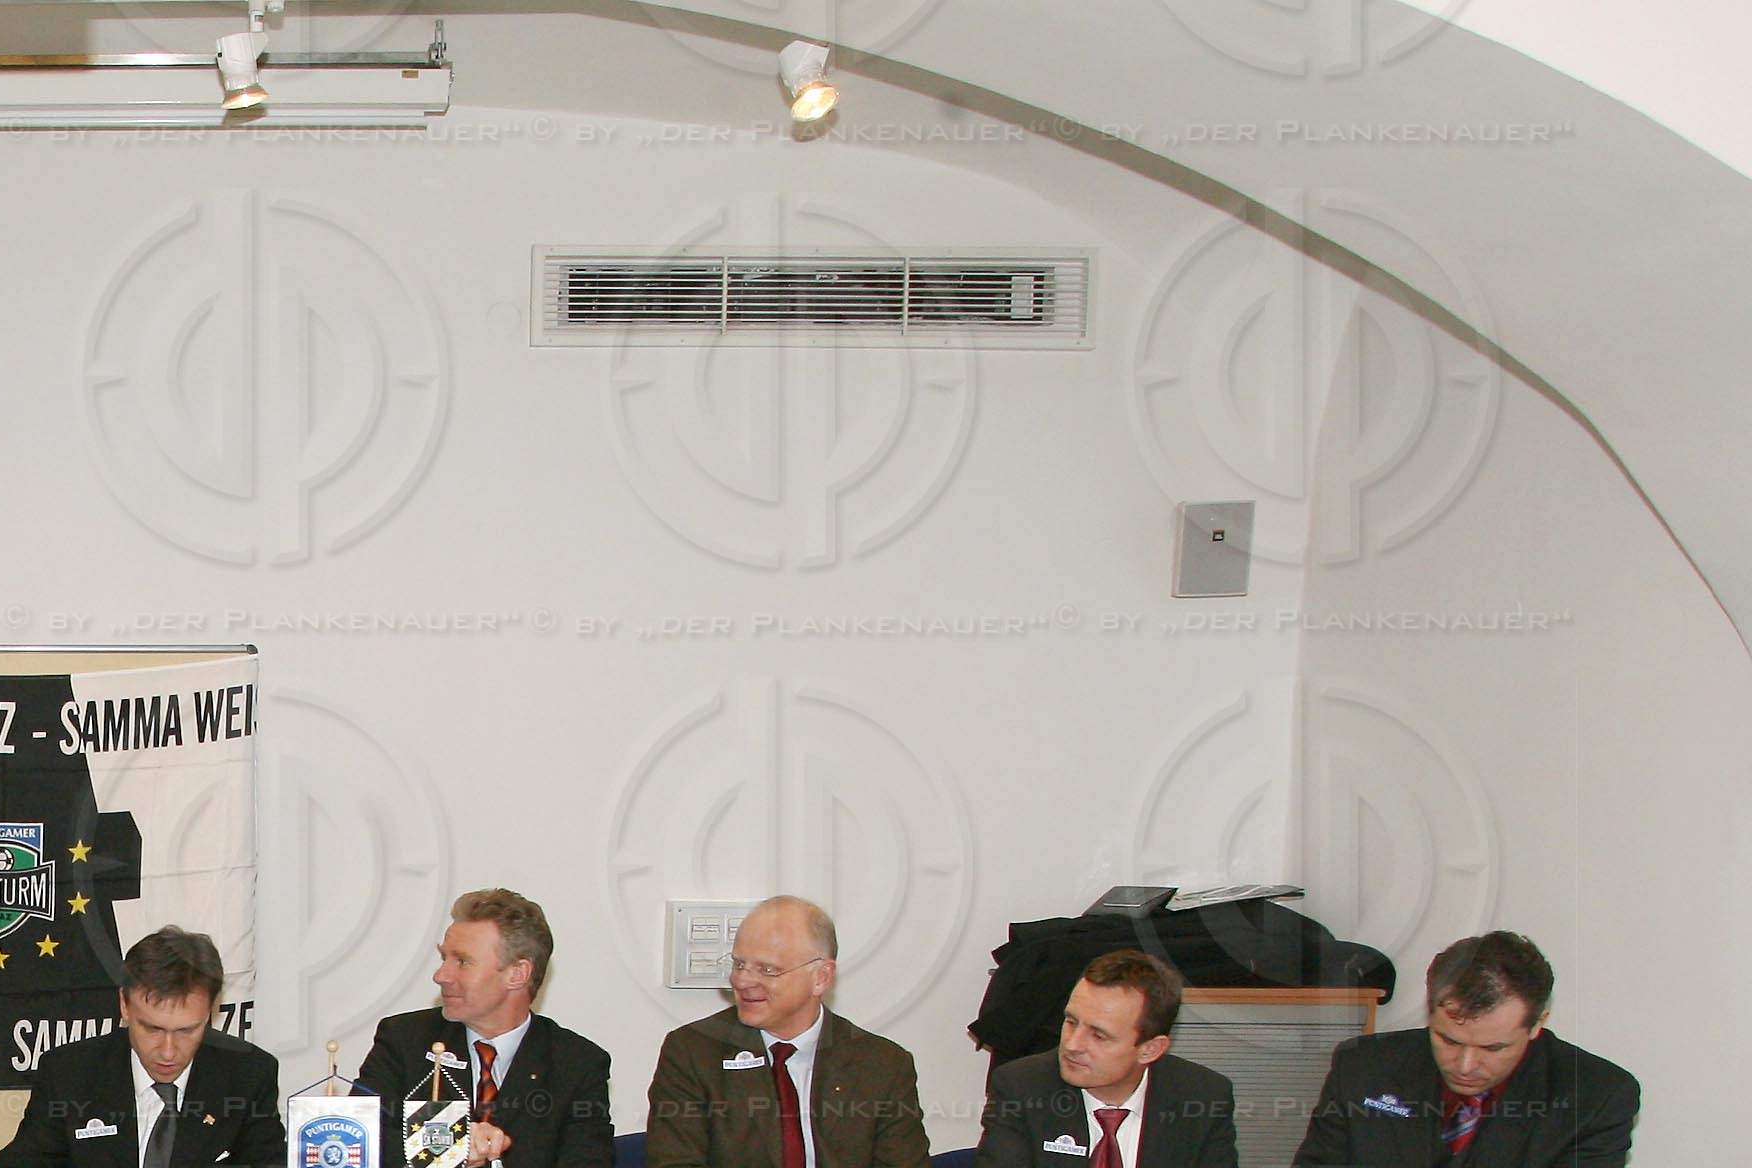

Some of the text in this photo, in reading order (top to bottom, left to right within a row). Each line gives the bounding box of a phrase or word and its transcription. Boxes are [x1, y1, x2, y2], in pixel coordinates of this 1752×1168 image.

[59, 694, 184, 755] SAMMA
[194, 684, 257, 743] WEI
[304, 1122, 363, 1139] PUNTIGAMER
